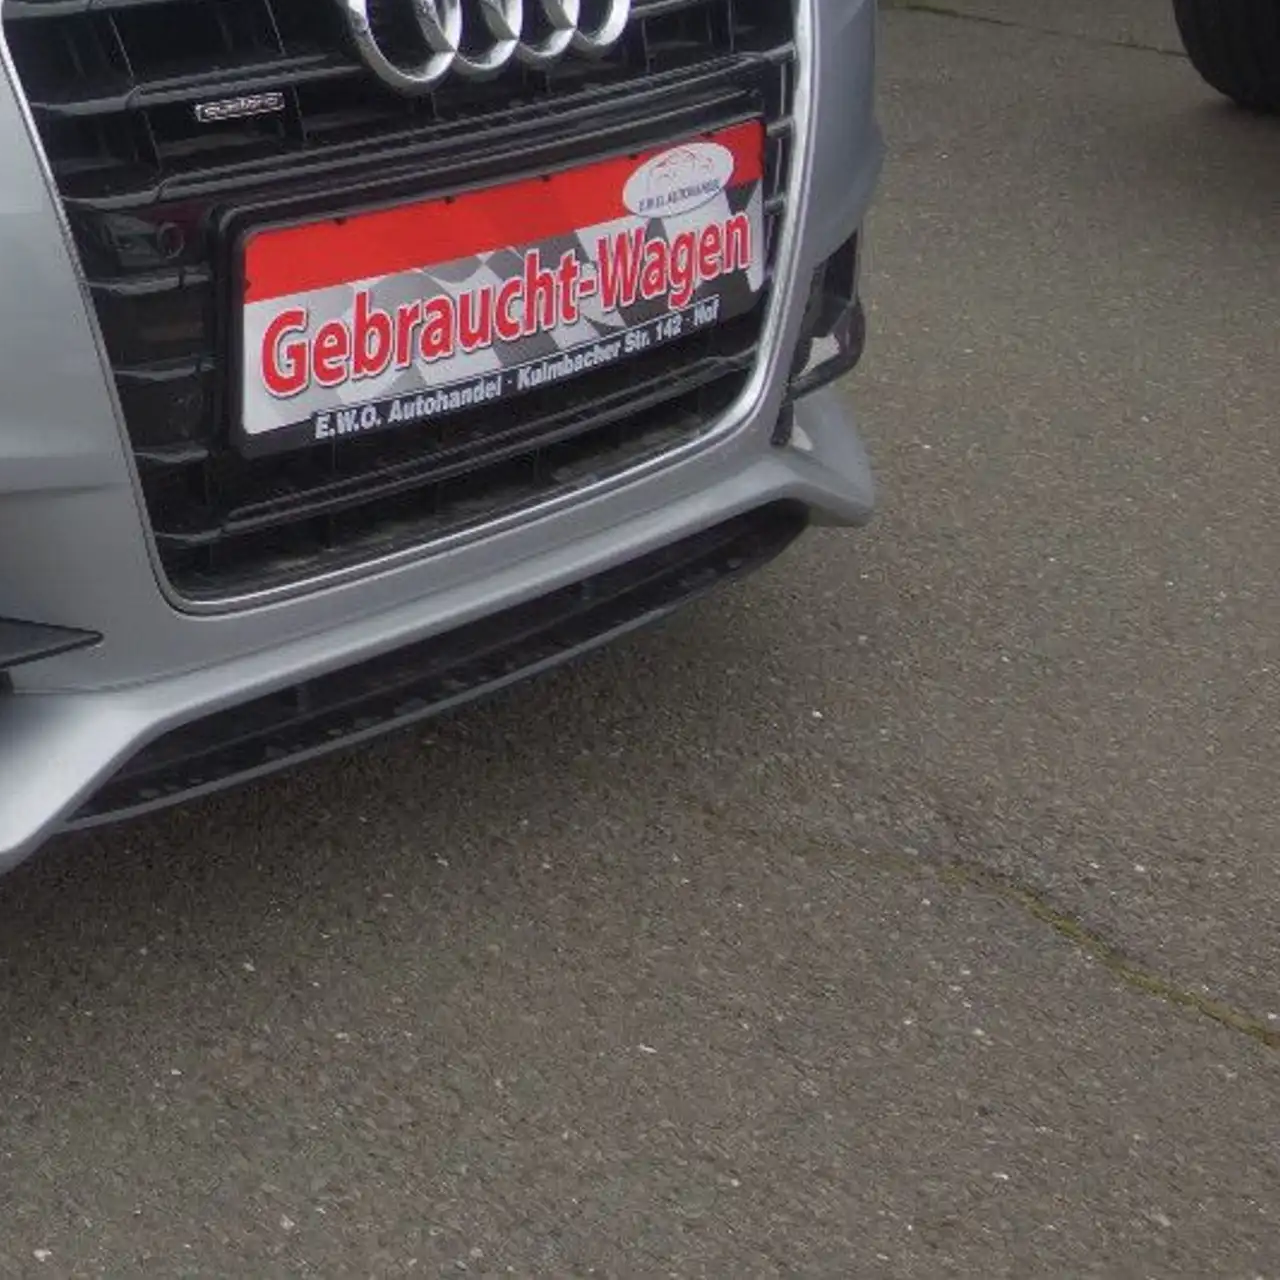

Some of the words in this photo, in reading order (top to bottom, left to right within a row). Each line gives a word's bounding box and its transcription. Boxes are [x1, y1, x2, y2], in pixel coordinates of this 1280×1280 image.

[260, 210, 752, 398] Gebraucht-Wagen
[315, 403, 381, 440] E.W.O.
[388, 375, 502, 424] Autohandel
[517, 340, 621, 391] Kulmbacher
[655, 311, 682, 341] 142
[693, 299, 720, 327] Hof
